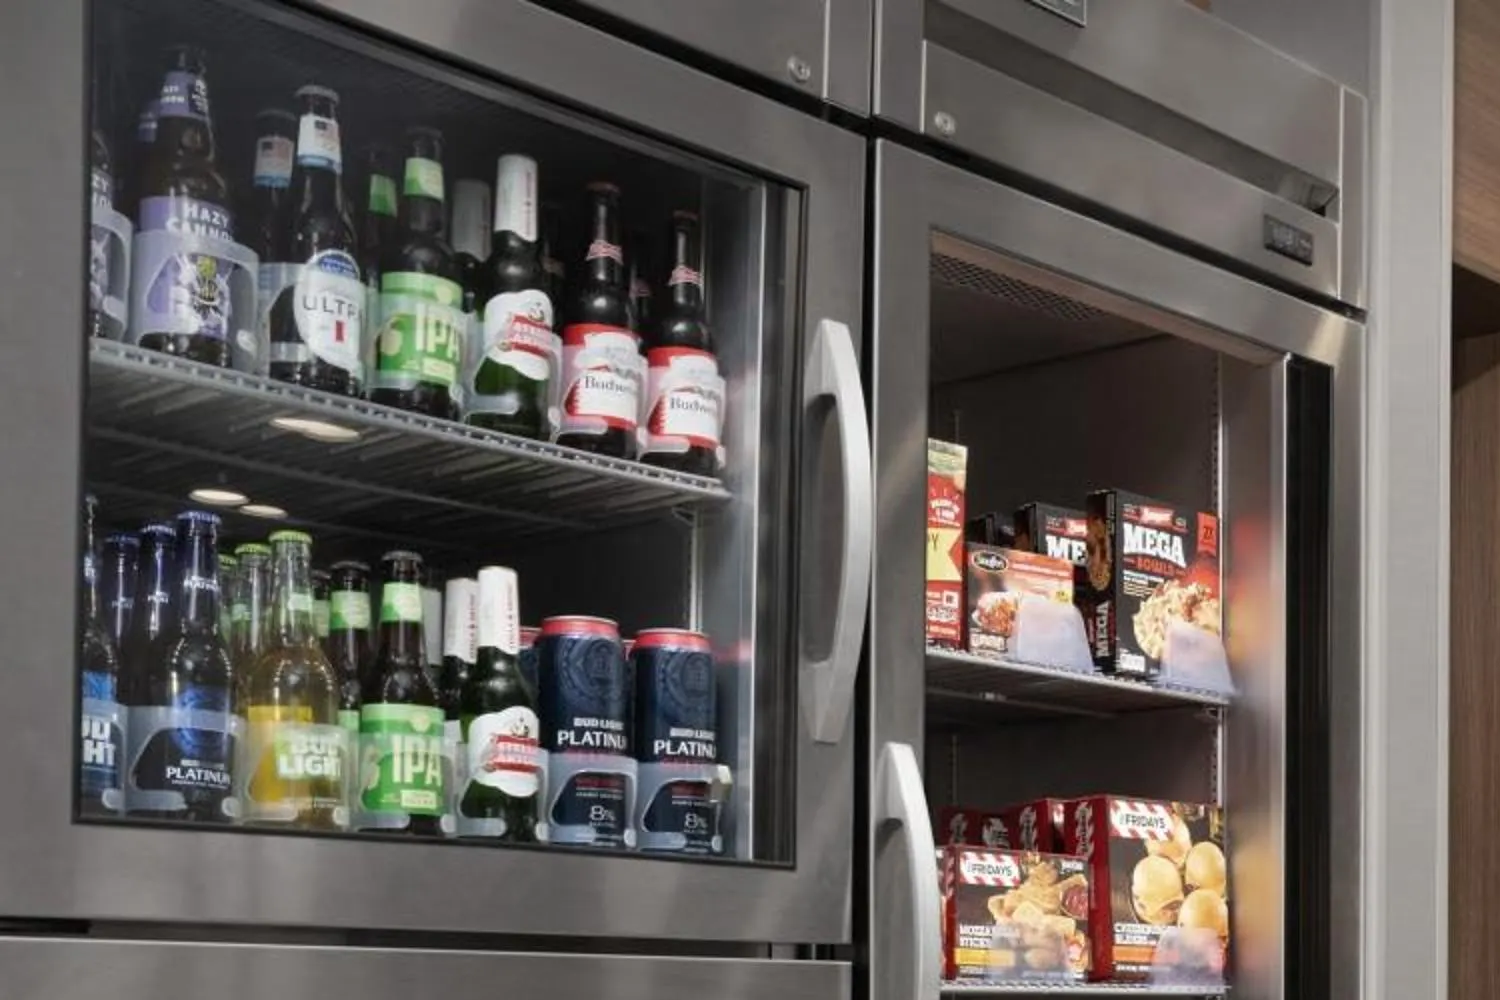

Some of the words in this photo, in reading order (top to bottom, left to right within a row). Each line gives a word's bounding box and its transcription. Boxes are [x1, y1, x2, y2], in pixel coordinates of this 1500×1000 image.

[183, 202, 230, 228] HAZY
[1045, 535, 1091, 567] ME
[1123, 521, 1187, 569] MEGA
[391, 734, 442, 787] IPA
[1125, 813, 1166, 830] FRIDAYS
[971, 862, 1013, 877] FRIDAYS
